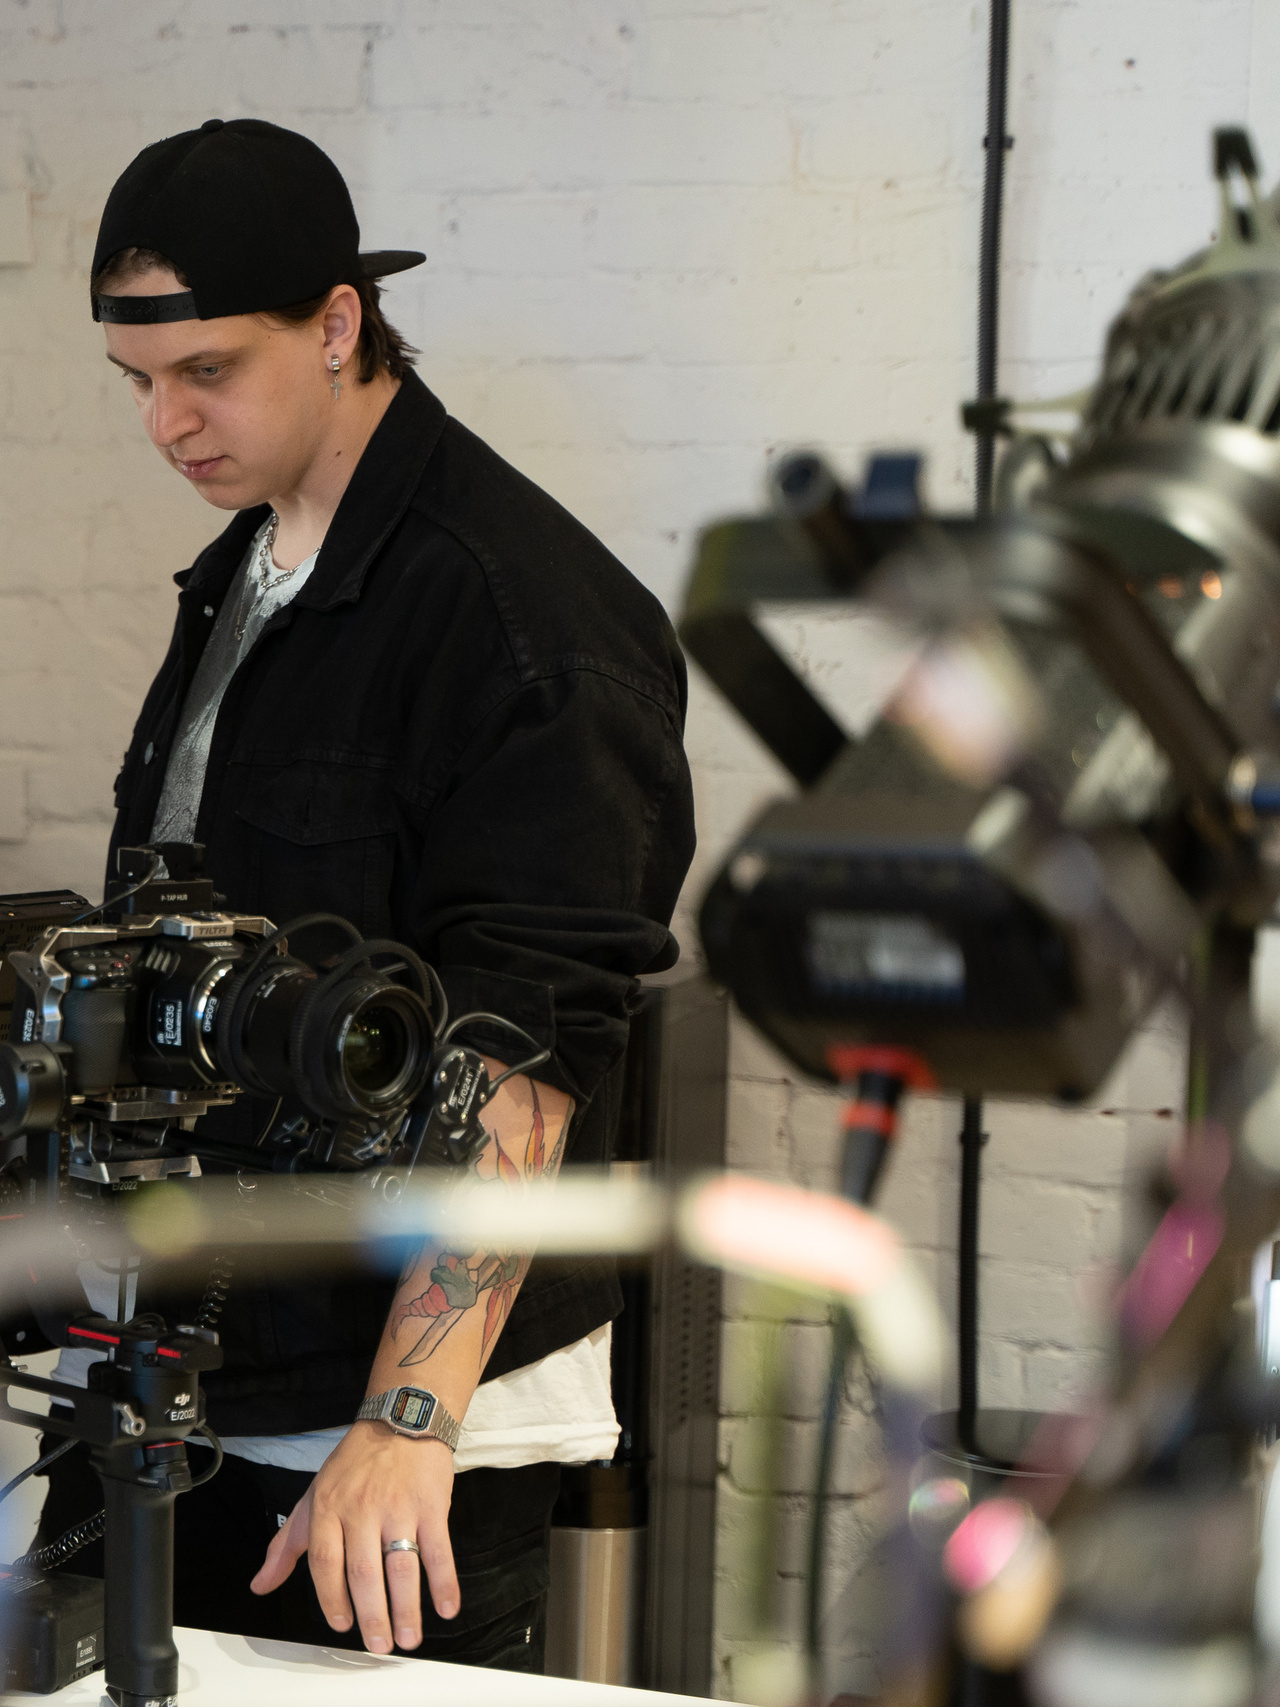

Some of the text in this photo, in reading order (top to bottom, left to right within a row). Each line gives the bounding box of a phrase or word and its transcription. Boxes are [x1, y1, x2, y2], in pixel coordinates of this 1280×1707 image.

[177, 893, 188, 901] HUB
[199, 927, 227, 935] TILTA
[204, 998, 217, 1032] E/0540
[165, 1004, 175, 1040] E/0235
[458, 1071, 474, 1106] E/0241
[111, 1181, 138, 1191] E/2022
[175, 1392, 191, 1406] dji
[171, 1408, 196, 1421] E/2022
